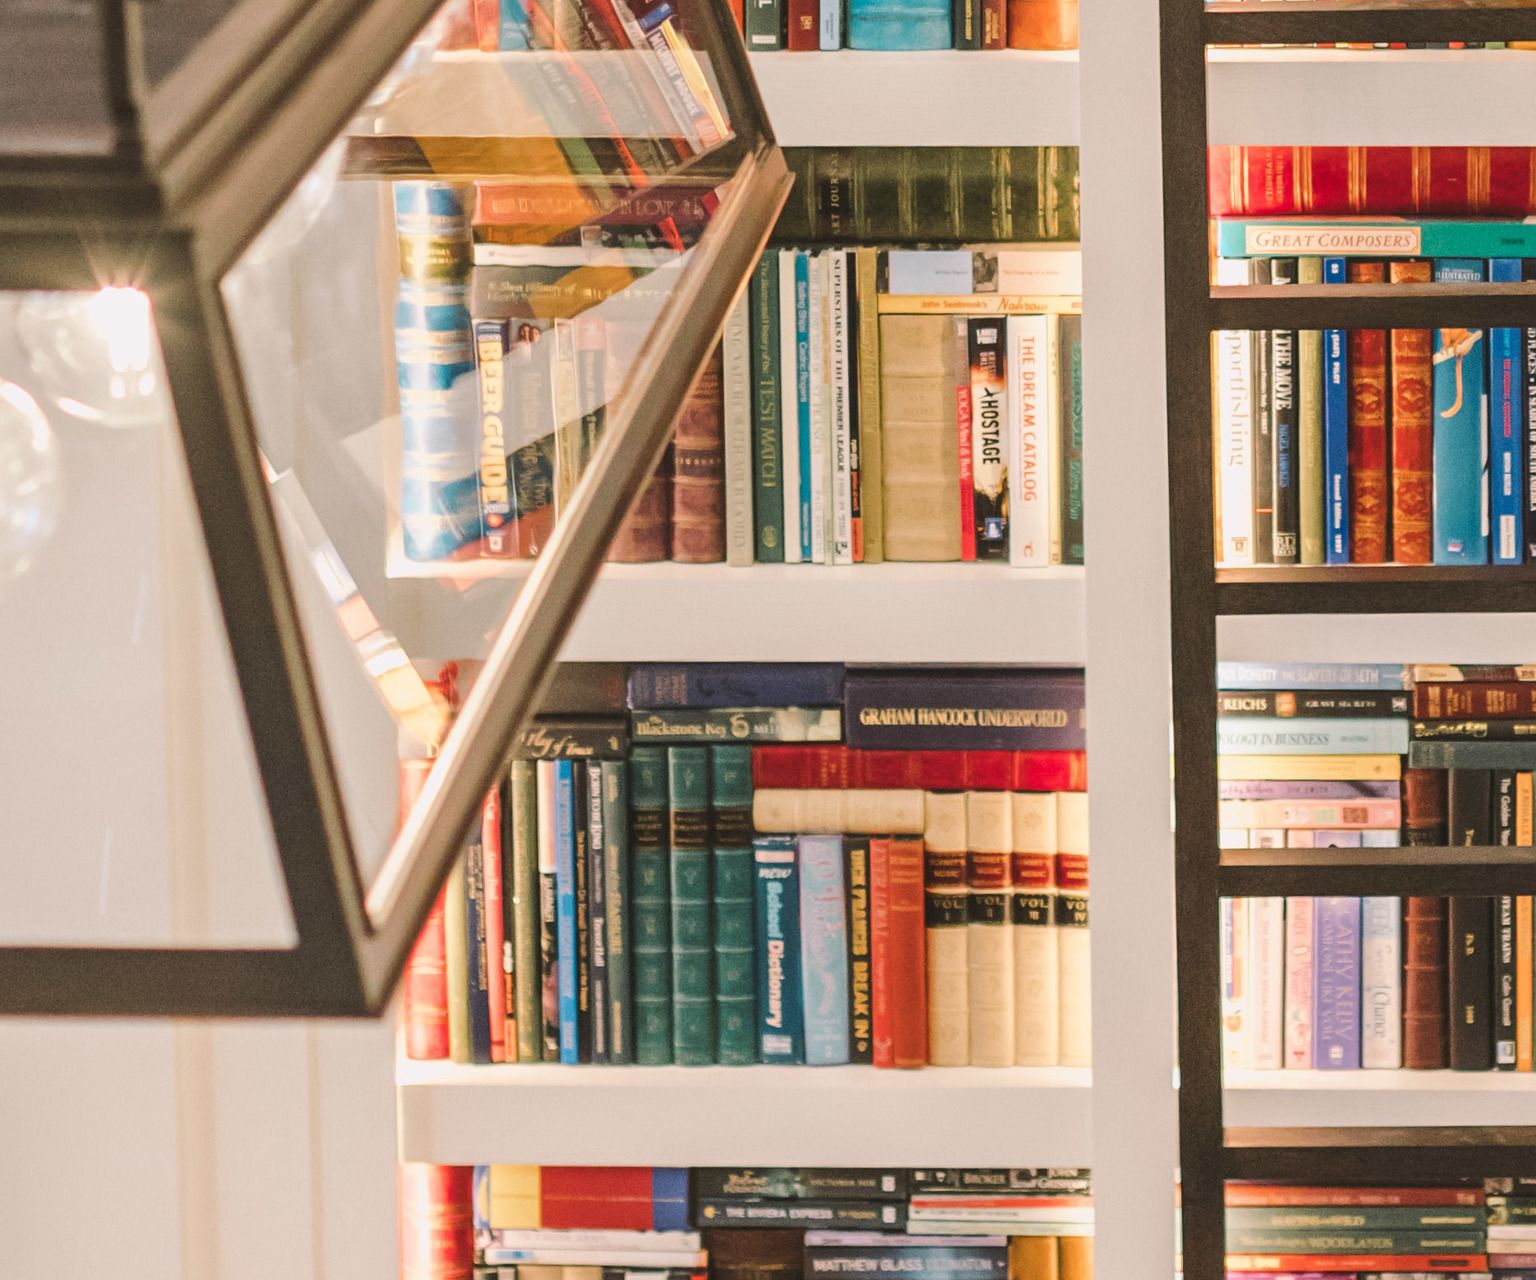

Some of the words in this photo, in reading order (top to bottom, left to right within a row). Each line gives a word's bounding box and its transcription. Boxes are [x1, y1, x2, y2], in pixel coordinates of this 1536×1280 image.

[1255, 231, 1315, 248] GREAT
[1318, 231, 1411, 248] COMPOSERS
[834, 258, 842, 335] SUPERSTARS
[835, 340, 843, 355] OF
[1021, 337, 1036, 363] THE
[1276, 338, 1292, 363] THE
[1528, 340, 1536, 375] PLACES
[835, 360, 843, 381] THE
[1276, 366, 1292, 410] MOVE
[760, 376, 777, 422] TEST
[835, 386, 844, 430] PREMIER
[1021, 371, 1036, 428] DREAM
[981, 400, 1000, 465] HOSTAGE
[760, 427, 777, 488] MATCH
[836, 433, 845, 473] LEAGUE
[1021, 432, 1036, 502] CATALOG
[636, 723, 702, 737] Blackstone
[706, 723, 727, 739] Key
[860, 709, 916, 726] GRAHAM
[918, 709, 976, 726] HANCOCK
[979, 710, 1068, 727] UNDERWORLD
[1501, 778, 1511, 794] The
[851, 850, 867, 886] DICK
[767, 882, 783, 938] School
[852, 888, 867, 955] FRANCIS
[1322, 911, 1334, 974] SOMEONE
[767, 940, 785, 1027] Dictionary
[853, 961, 868, 1014] BREAK
[1322, 978, 1334, 1007] LIKE
[854, 1019, 868, 1037] IN
[1322, 1011, 1334, 1040] YOU
[1374, 991, 1388, 1039] Chance
[812, 1259, 876, 1273] MATTHEW
[880, 1259, 923, 1274] GLASS
